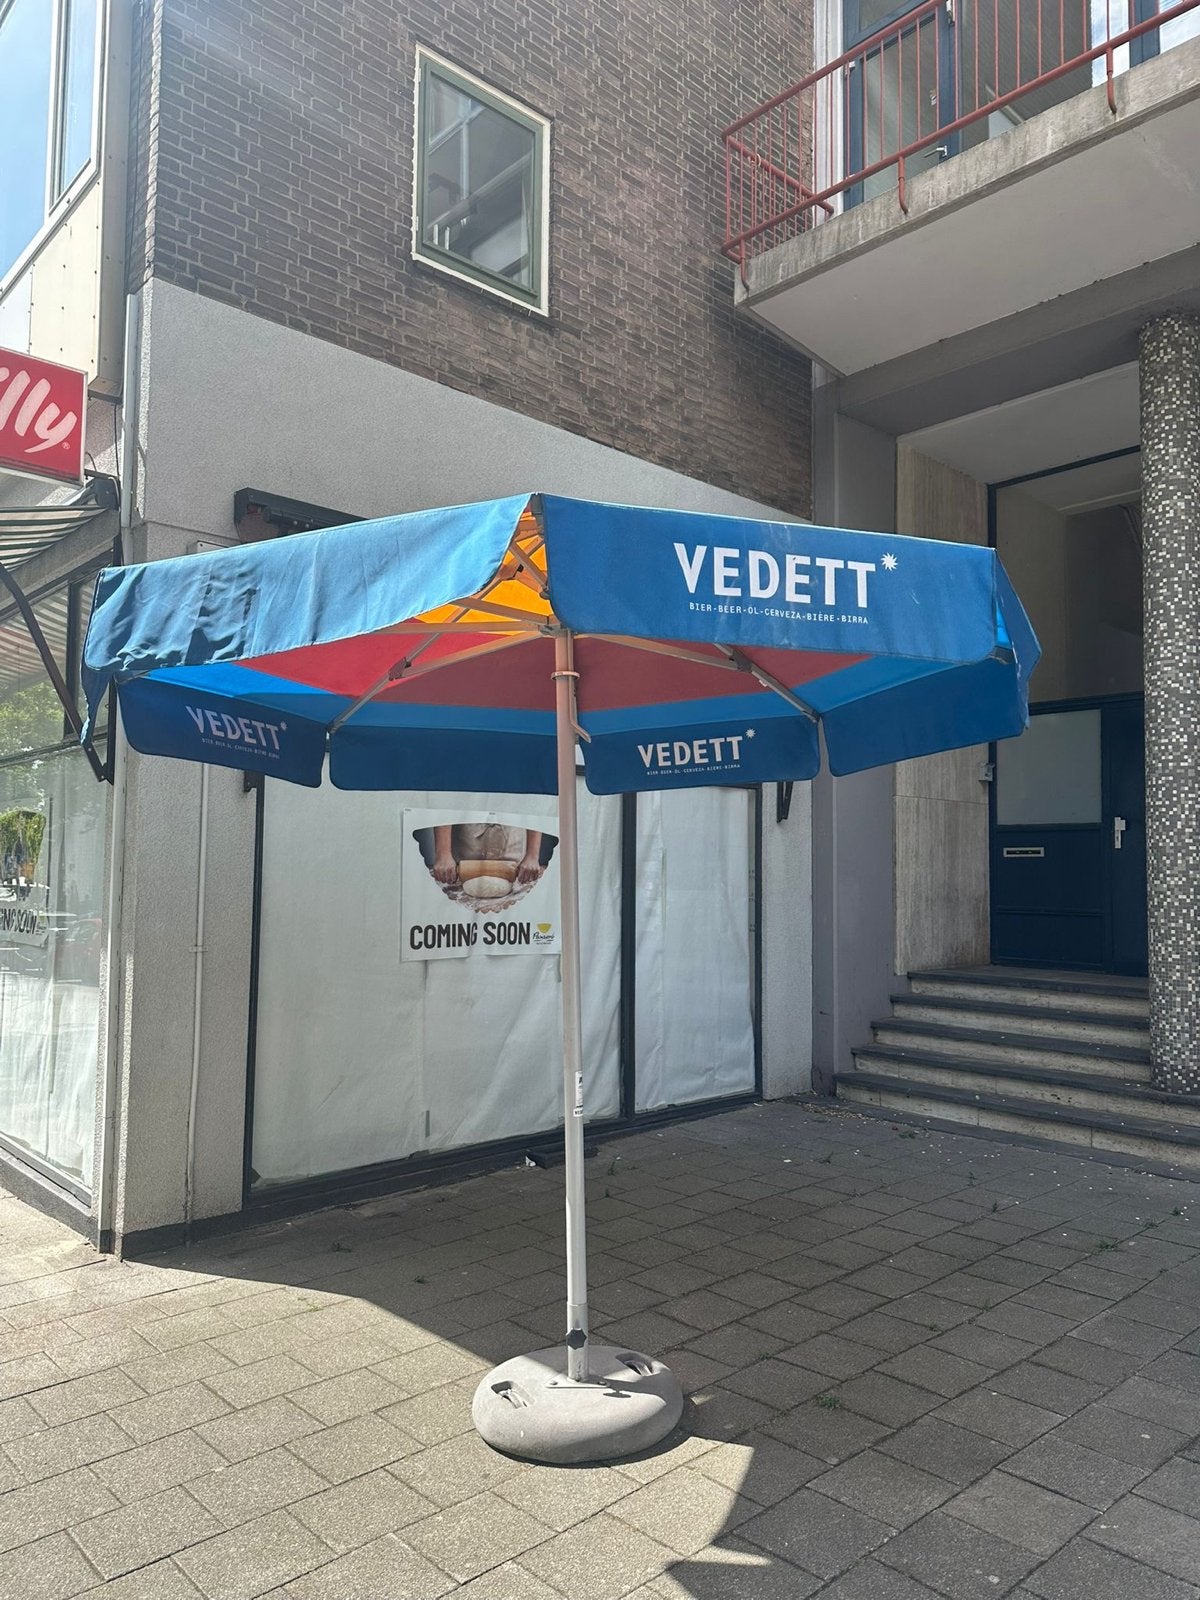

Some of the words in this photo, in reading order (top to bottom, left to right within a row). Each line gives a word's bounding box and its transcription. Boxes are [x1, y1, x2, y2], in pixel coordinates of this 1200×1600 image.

[673, 542, 876, 608] VEDETT
[185, 705, 280, 750] VEDETT
[637, 735, 743, 768] VEDETT
[410, 922, 478, 950] COMING
[482, 921, 531, 946] SOON
